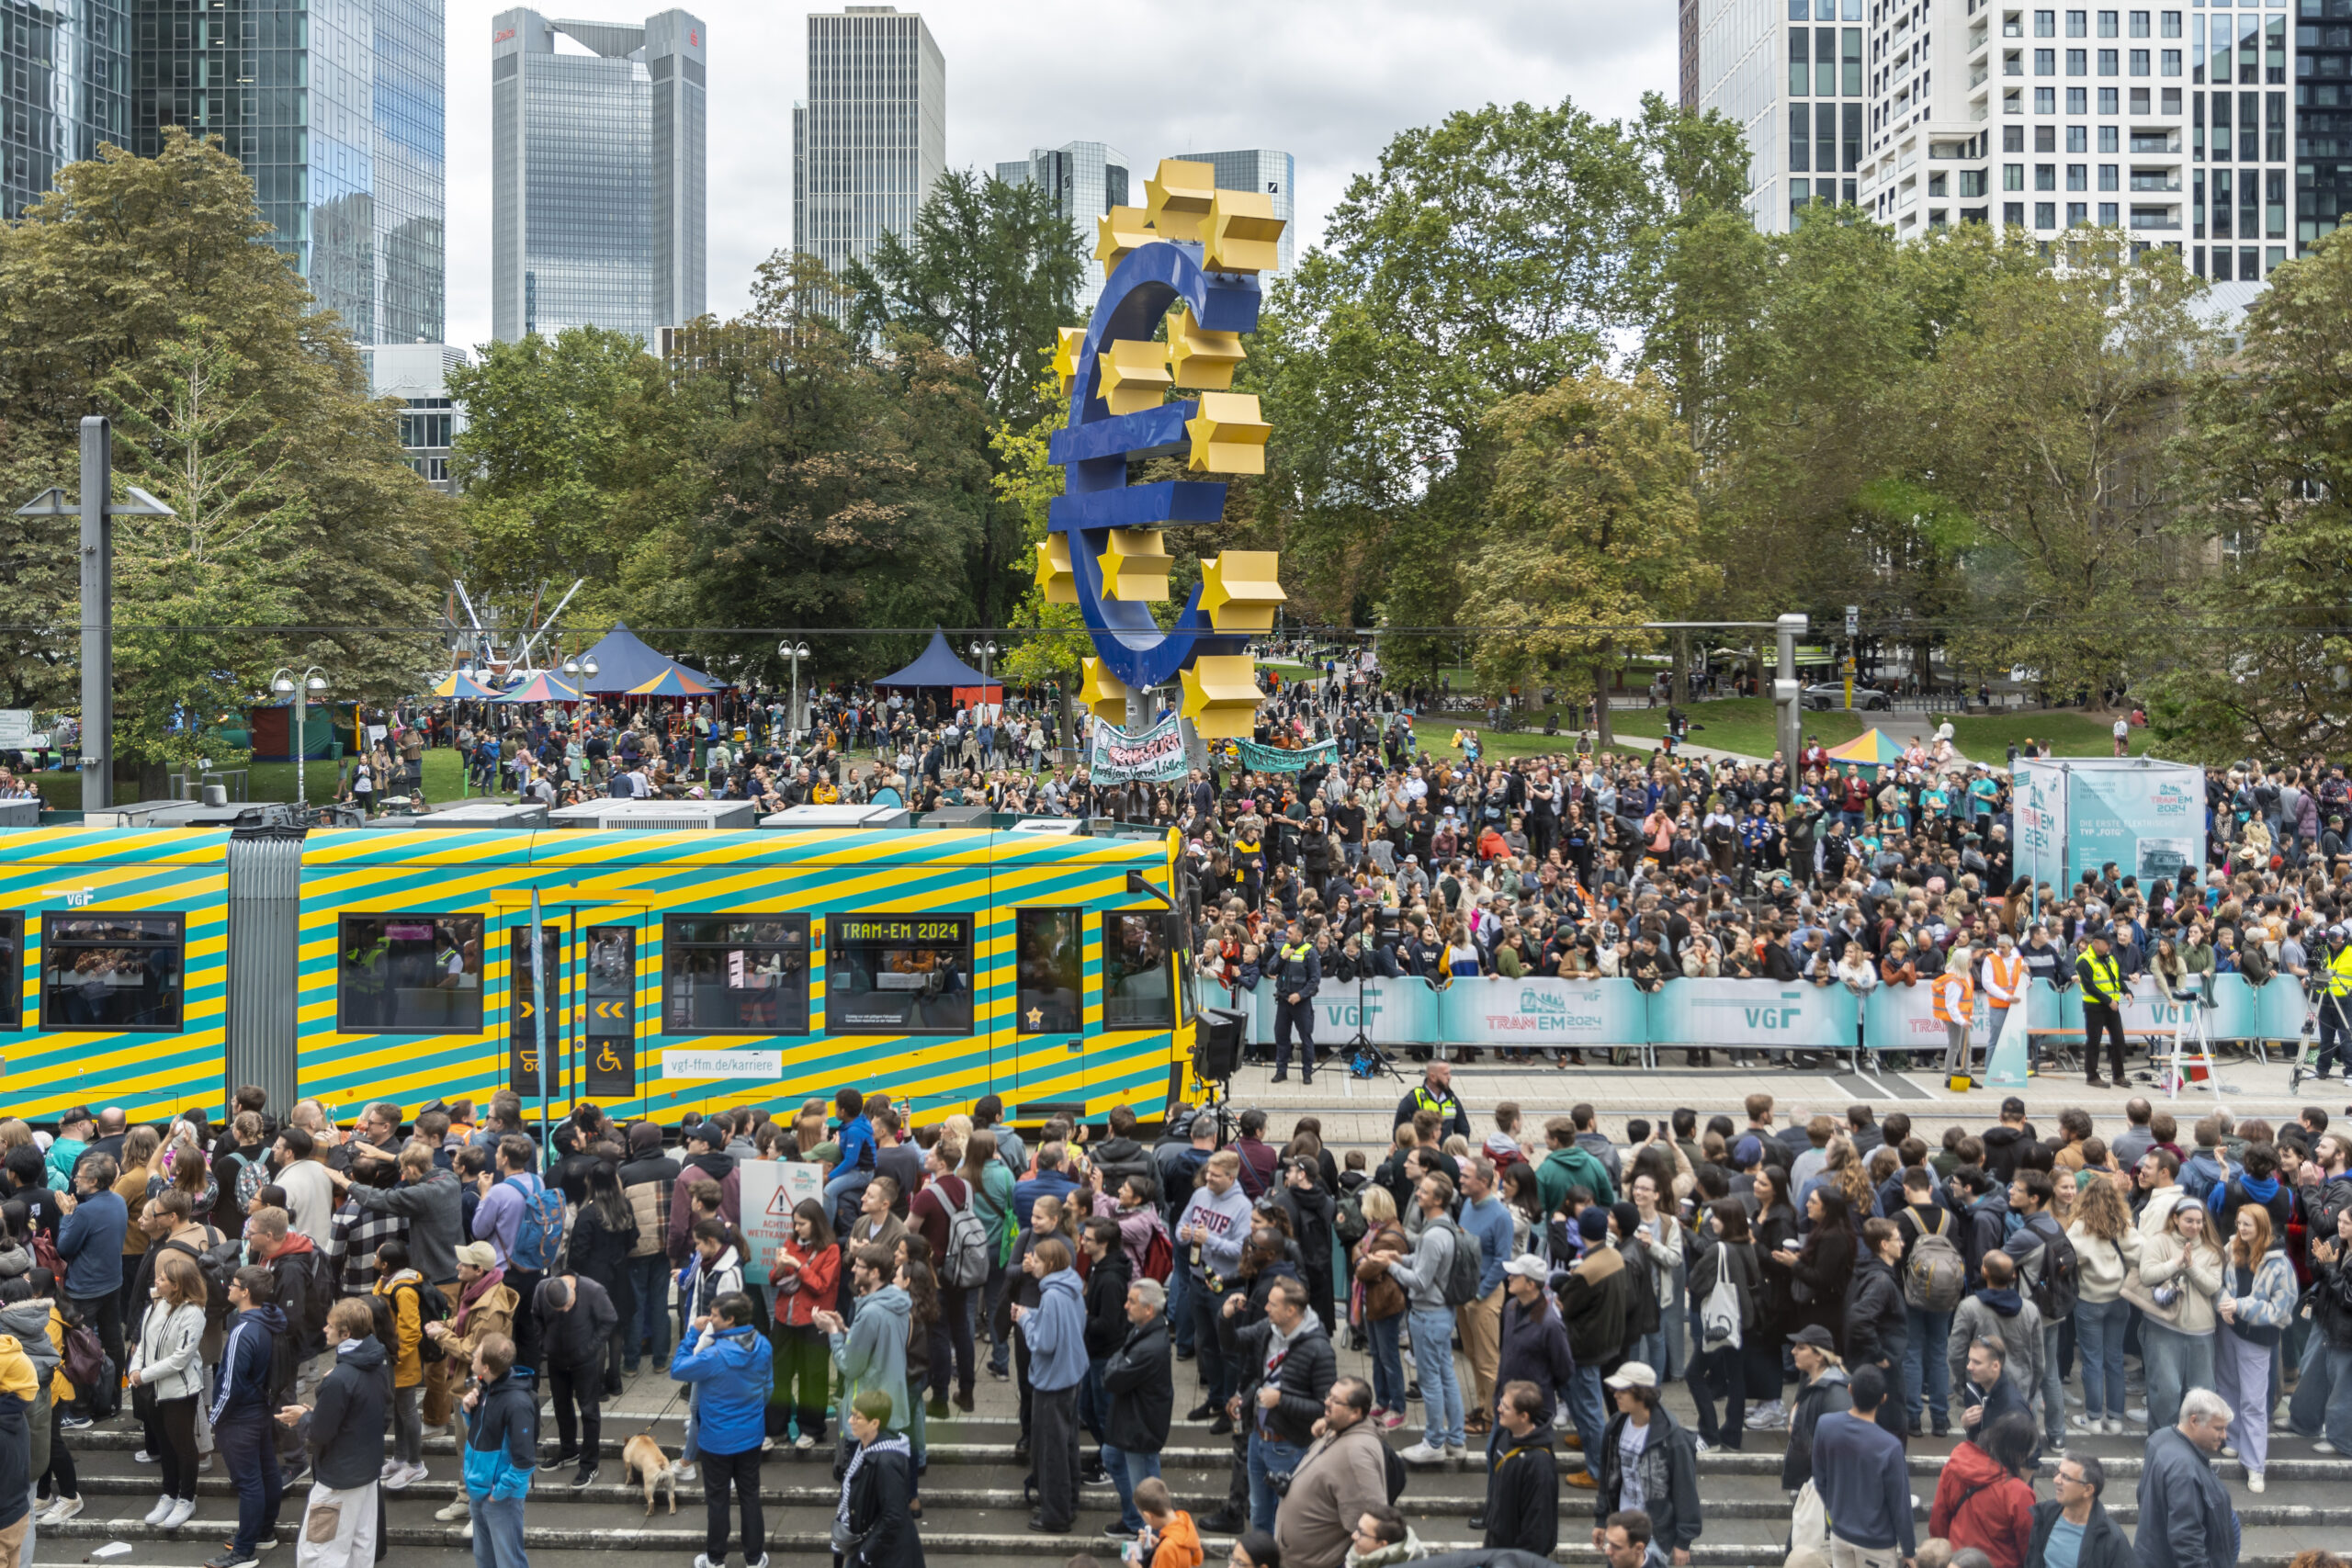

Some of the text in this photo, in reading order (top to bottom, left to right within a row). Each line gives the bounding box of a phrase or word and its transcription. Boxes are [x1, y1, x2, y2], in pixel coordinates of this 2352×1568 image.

[2156, 804, 2187, 813] 2024
[2079, 828, 2095, 836] TYP
[67, 886, 95, 906] VGF
[842, 922, 959, 940] TRAM-EM 2024
[1327, 989, 1383, 1027] VGF
[1745, 992, 1802, 1029] VGF
[1566, 1016, 1601, 1026] 2024
[1908, 1018, 1948, 1033] TRA
[671, 1058, 773, 1073] vgf-ffm.de/karriere
[763, 1220, 794, 1229] ACHTU
